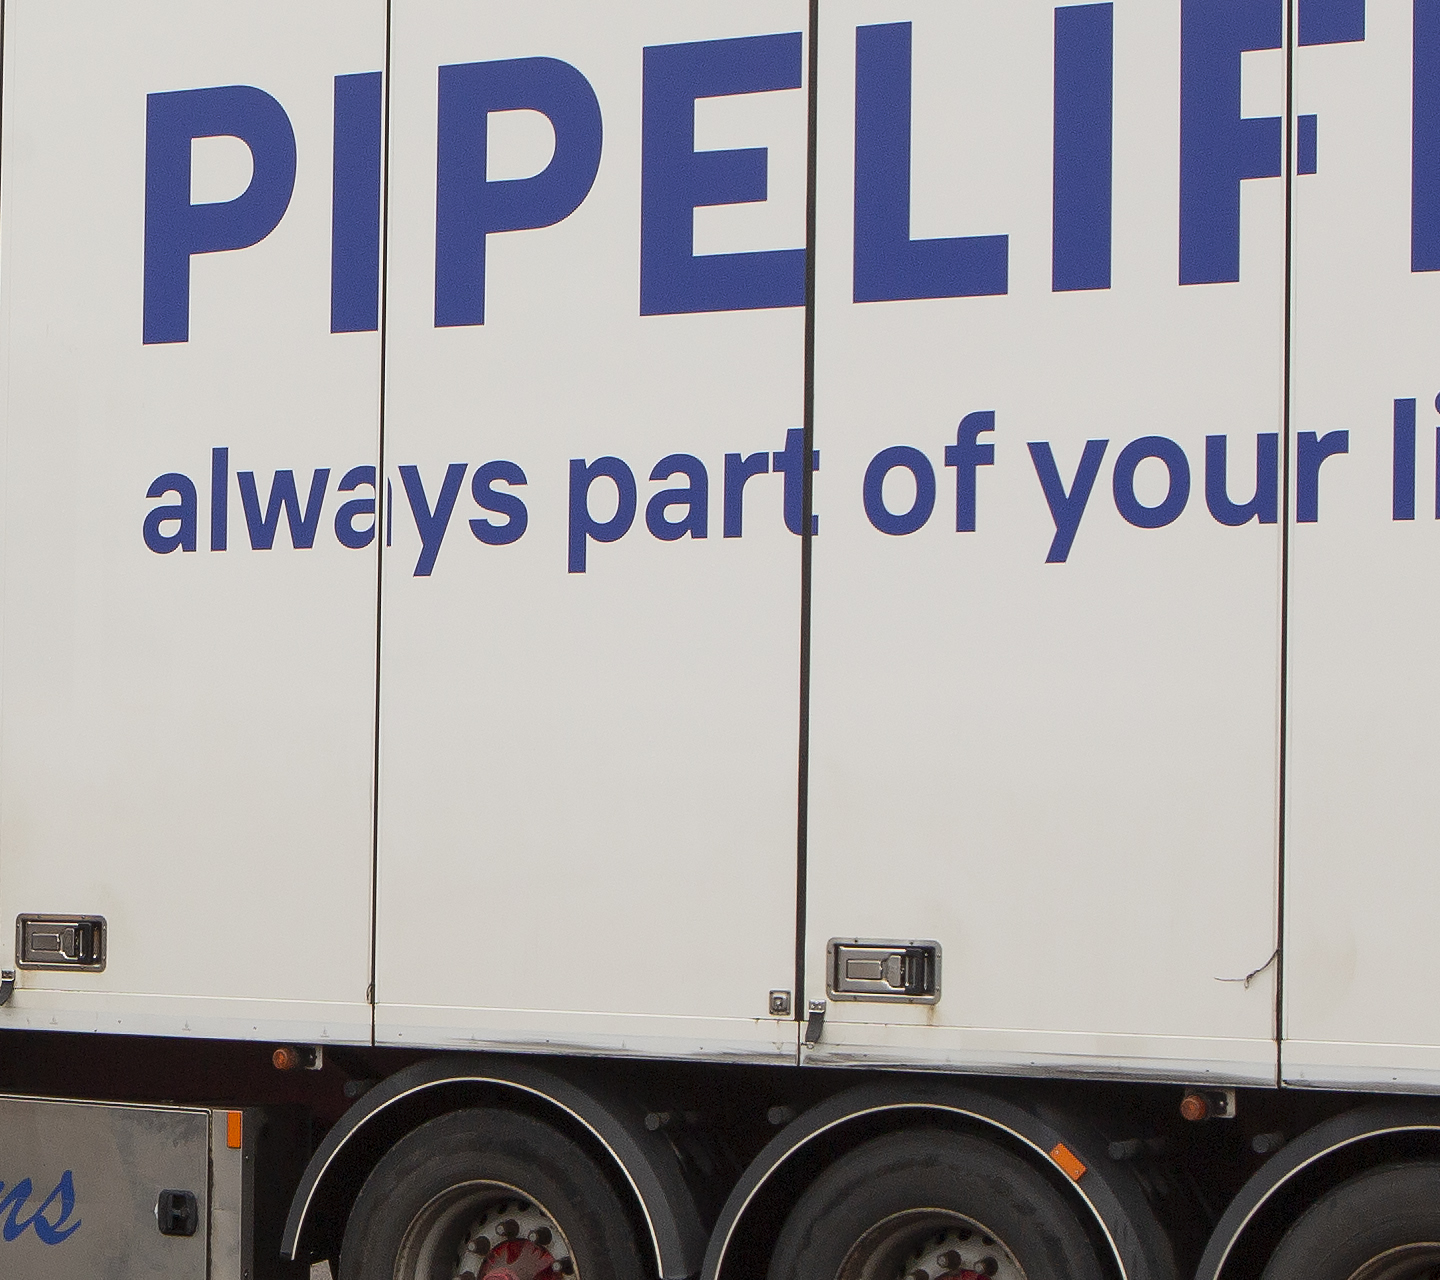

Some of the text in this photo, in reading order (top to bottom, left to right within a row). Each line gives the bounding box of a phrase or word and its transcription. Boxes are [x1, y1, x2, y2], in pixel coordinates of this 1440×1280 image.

[141, 446, 529, 577] always
[567, 427, 820, 574] part
[861, 410, 996, 537] of
[1025, 428, 1350, 564] your
